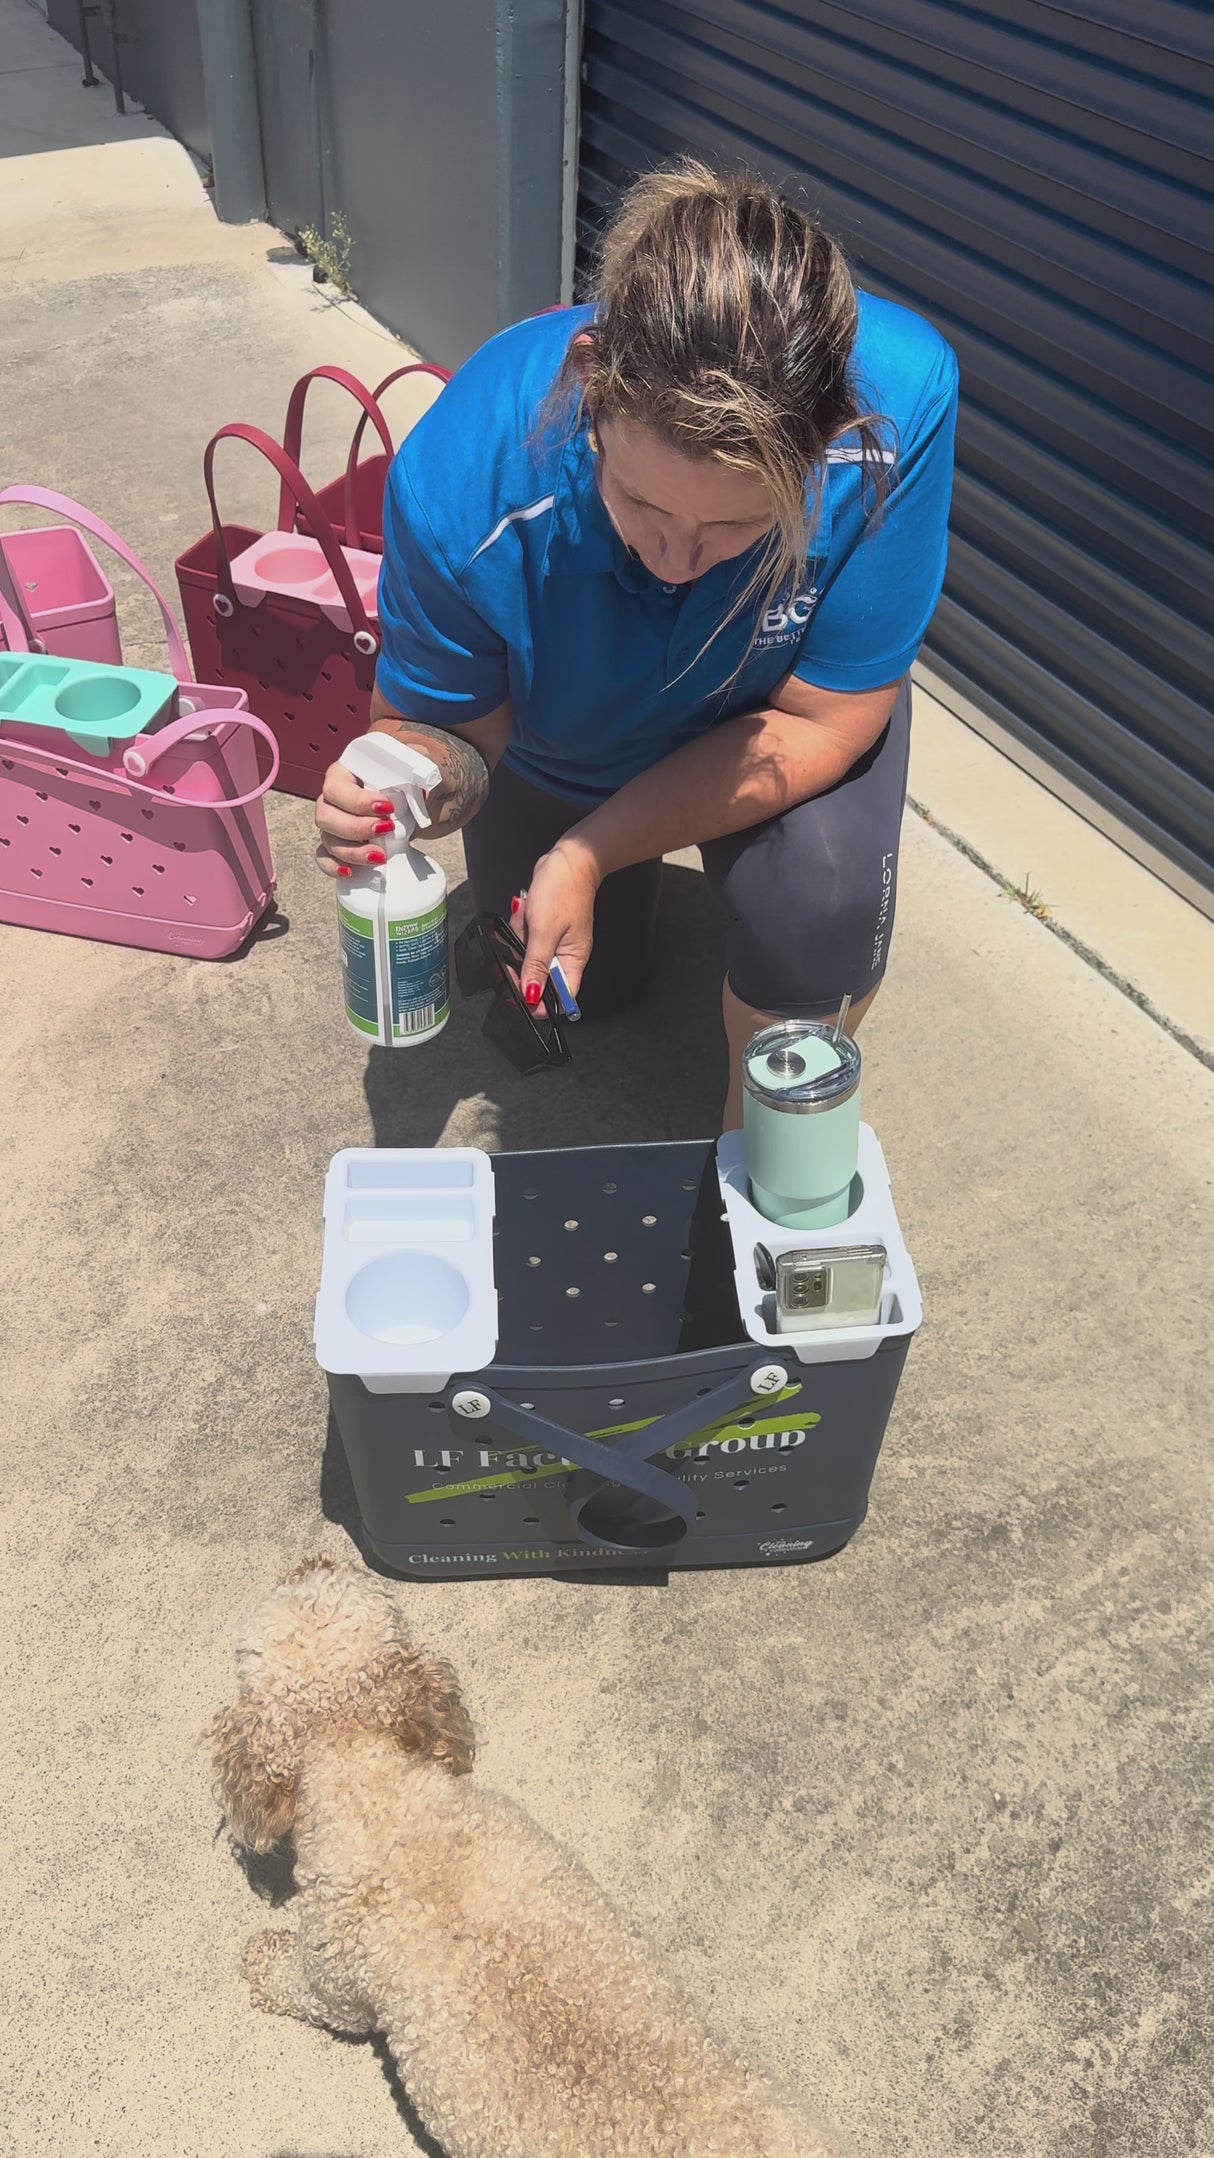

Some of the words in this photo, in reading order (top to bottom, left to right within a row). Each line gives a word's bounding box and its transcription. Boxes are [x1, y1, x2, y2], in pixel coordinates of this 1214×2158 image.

[754, 637, 775, 646] THE
[876, 853, 893, 930] LORNA
[757, 1372, 780, 1391] LF
[457, 1399, 481, 1414] LF
[411, 1449, 464, 1468] LF
[665, 1429, 806, 1460] Group
[432, 1481, 537, 1490] Commercial
[714, 1464, 788, 1480] Services
[408, 1551, 497, 1564] Cleaning
[502, 1549, 550, 1560] With
